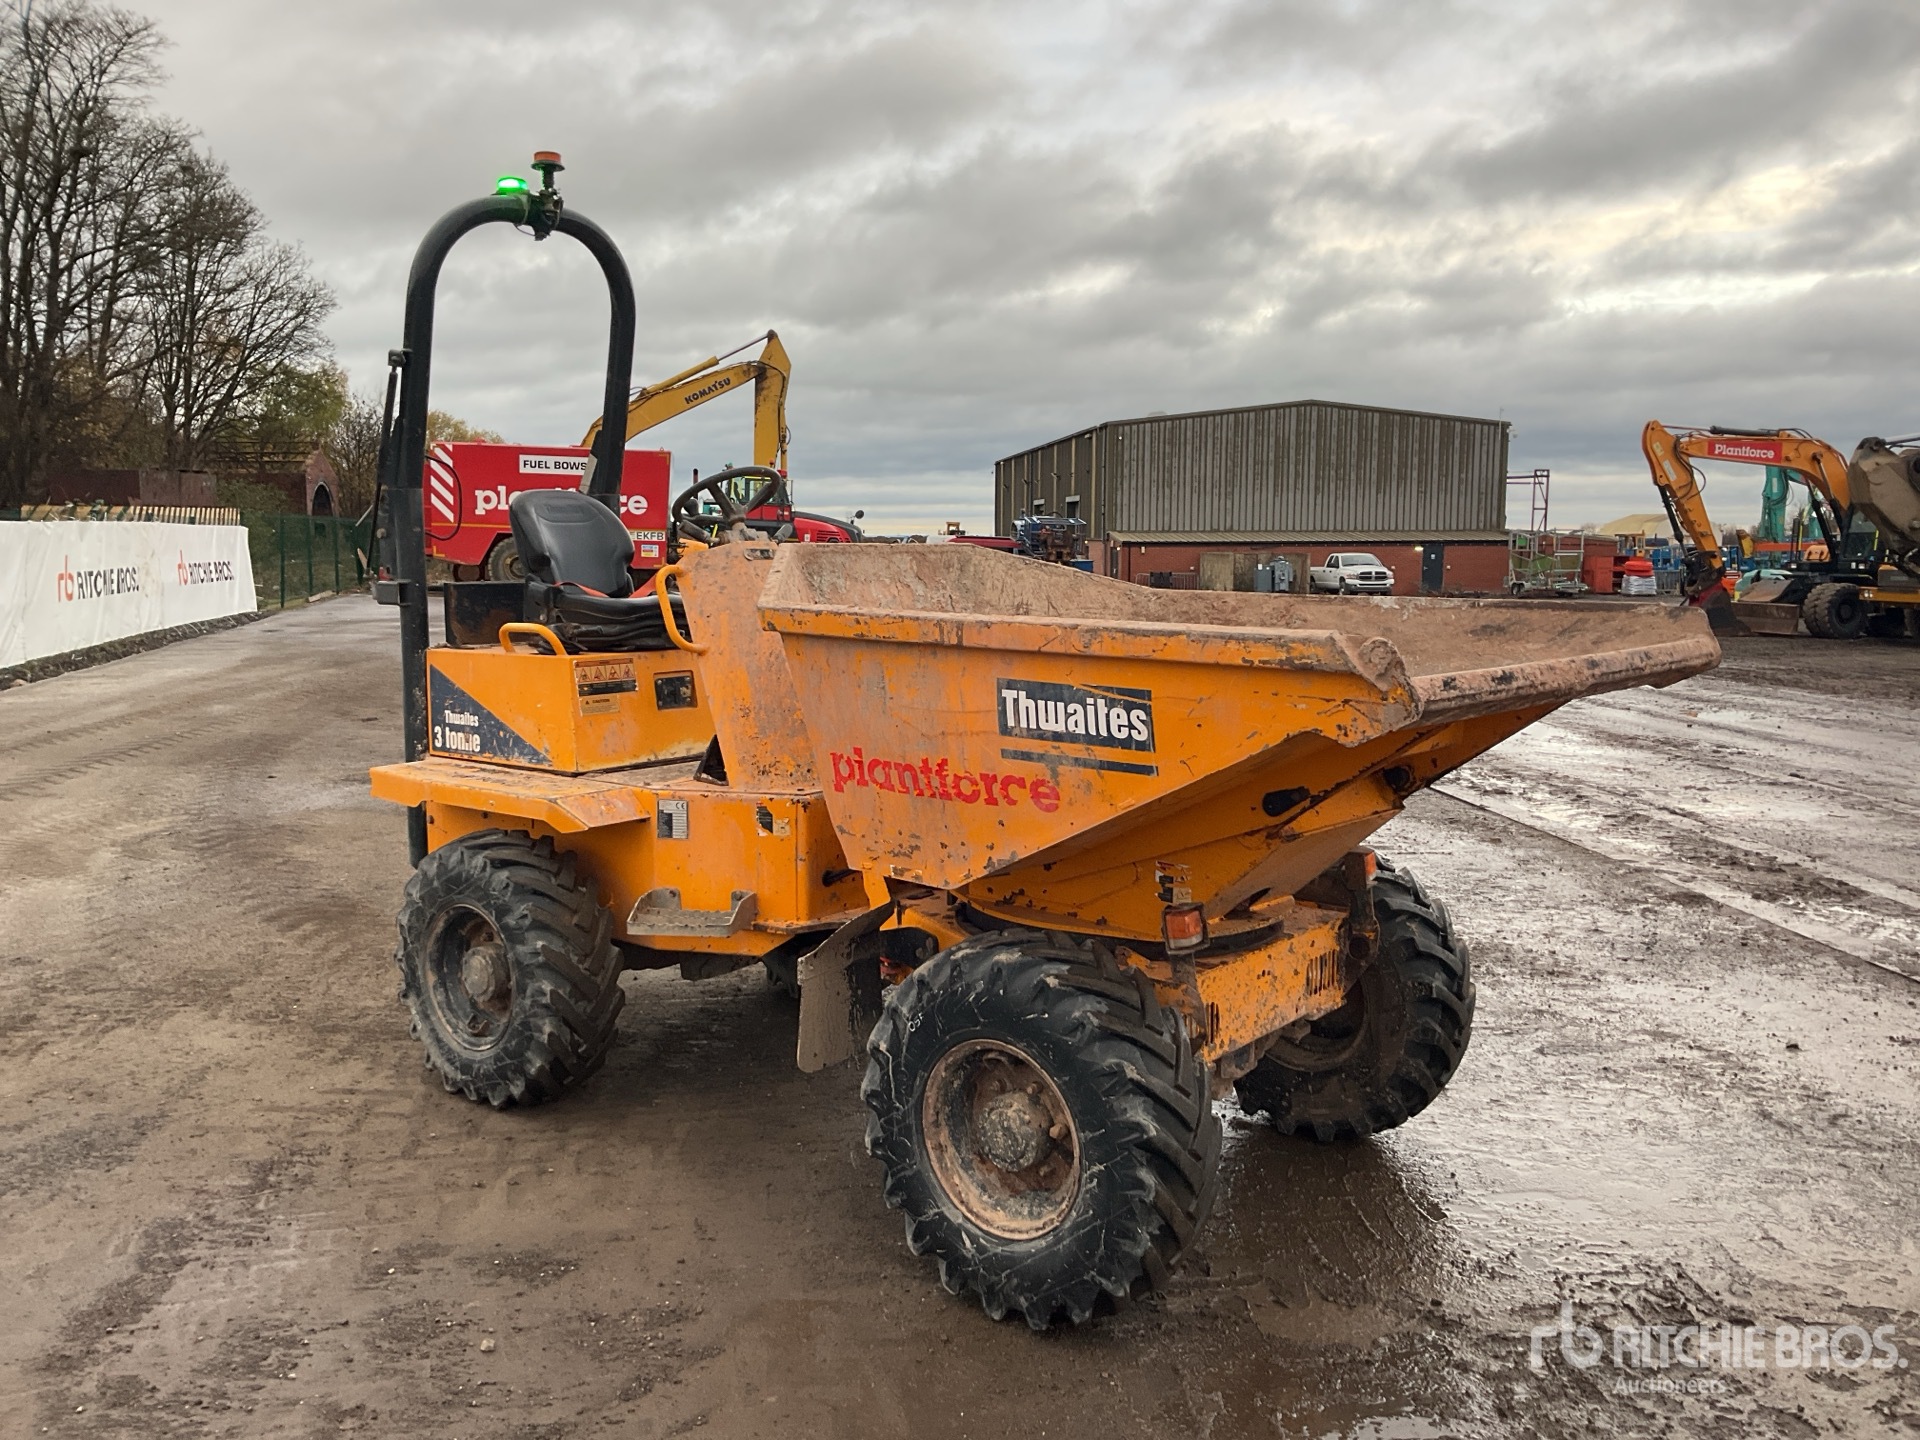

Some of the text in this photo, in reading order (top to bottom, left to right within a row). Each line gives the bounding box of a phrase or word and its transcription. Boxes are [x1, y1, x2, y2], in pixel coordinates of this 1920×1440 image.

[684, 377, 731, 405] KOMATSU
[1714, 443, 1775, 458] Plantforce
[523, 460, 588, 471] FUEL BOWS
[444, 709, 479, 727] Thwaites
[1001, 688, 1149, 742] Thwaites
[433, 725, 481, 752] 3 tonne
[829, 746, 1061, 813] plantforce
